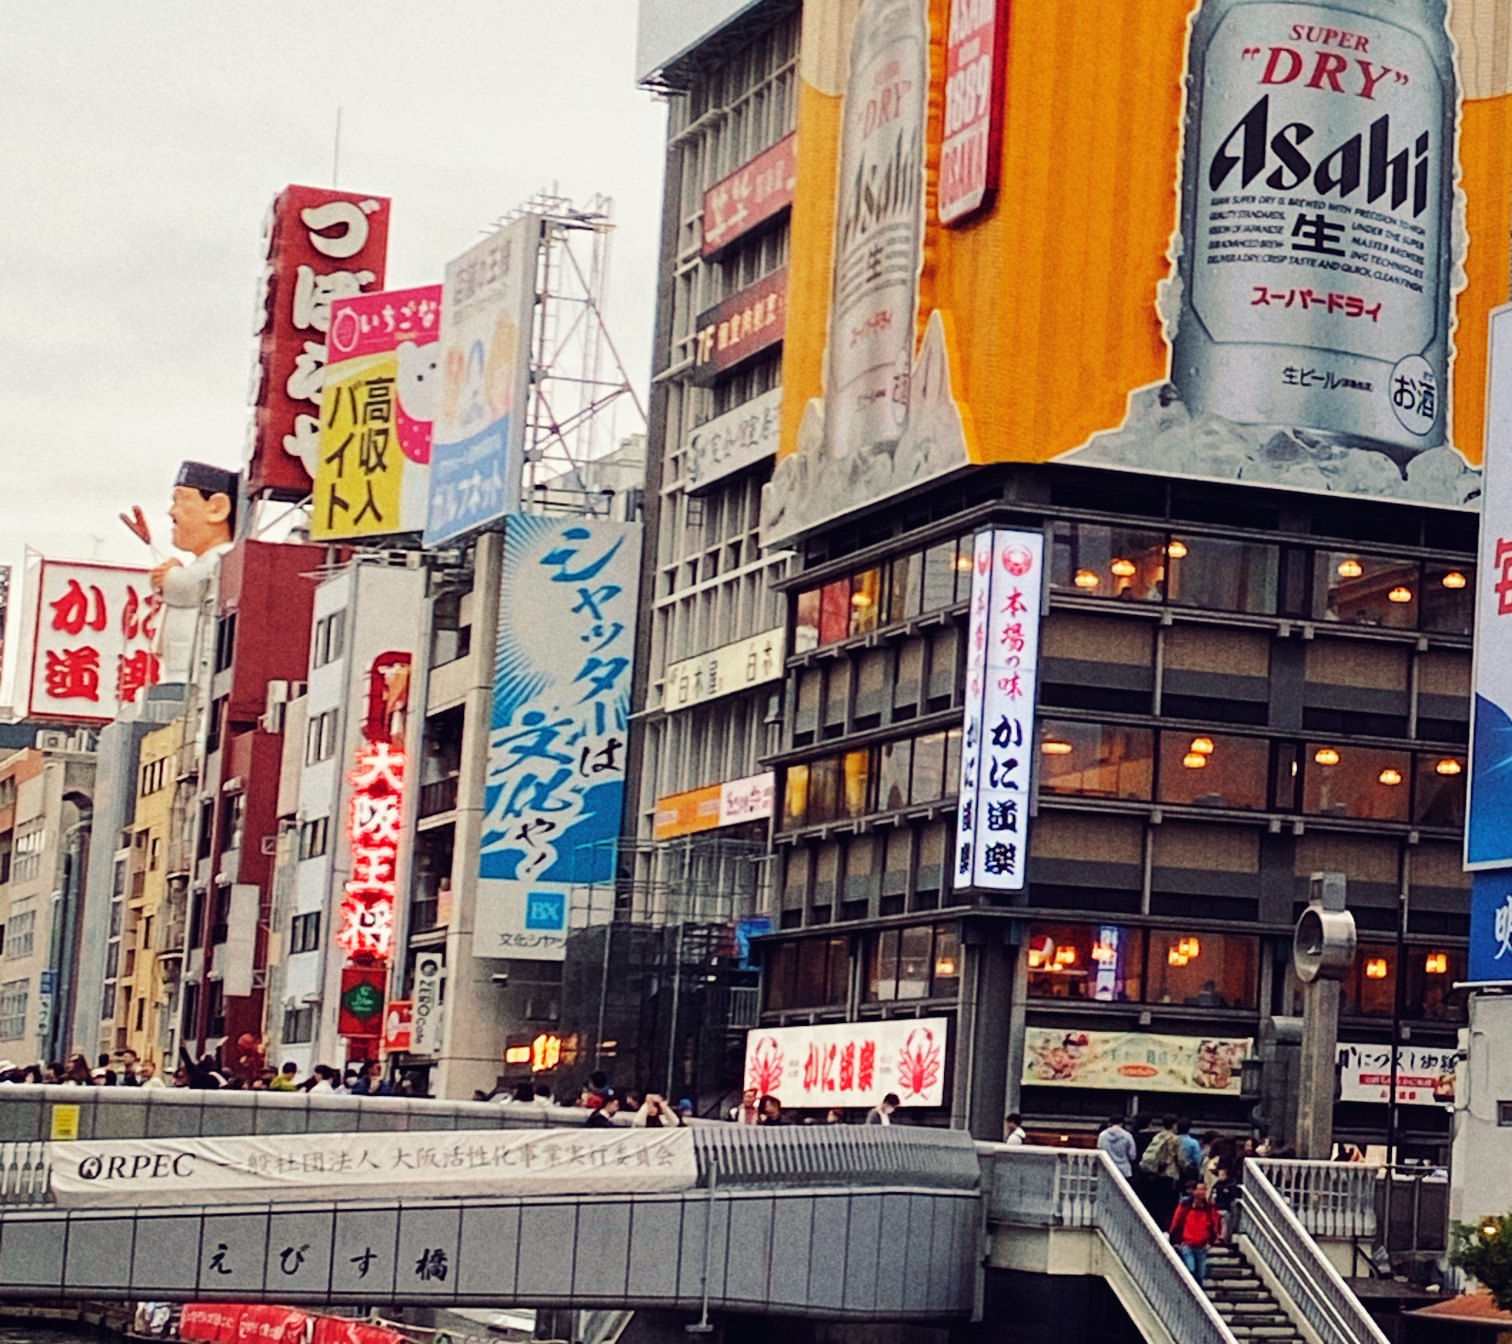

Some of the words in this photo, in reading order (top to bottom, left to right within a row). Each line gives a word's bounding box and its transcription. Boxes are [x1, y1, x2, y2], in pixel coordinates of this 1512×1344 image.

[1289, 23, 1371, 54] SUPER
[1208, 92, 1430, 219] Asahi
[1290, 213, 1347, 258] 生
[1250, 285, 1383, 323] スーパードライ
[1392, 374, 1437, 421] お酒
[324, 382, 366, 531] バイト
[352, 376, 396, 527] 高収入
[997, 585, 1028, 702] 本場の味
[338, 743, 404, 955] 大阪王将
[207, 1241, 450, 1284] えびす橋
